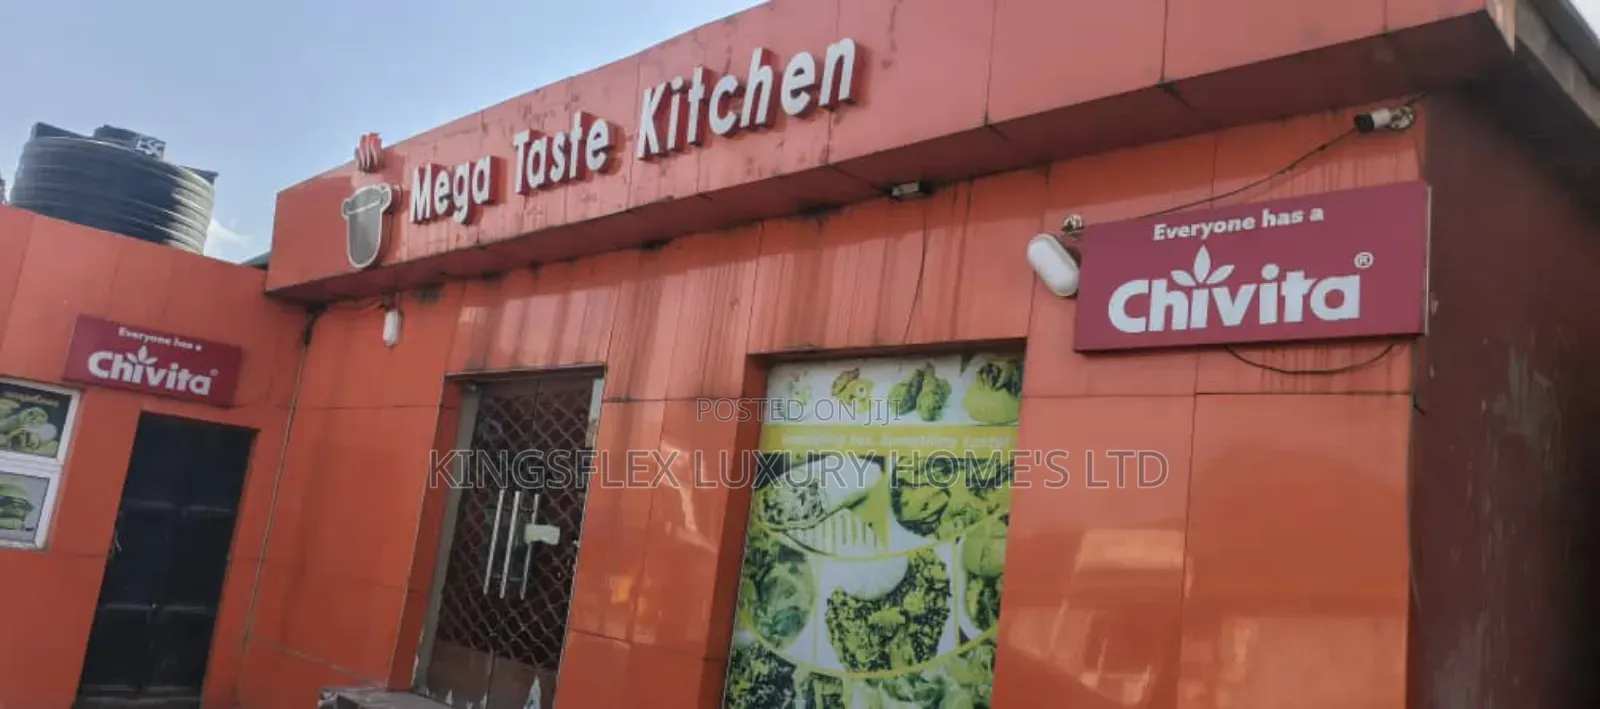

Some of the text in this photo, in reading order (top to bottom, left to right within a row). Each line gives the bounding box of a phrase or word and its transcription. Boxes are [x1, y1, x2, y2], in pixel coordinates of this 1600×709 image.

[409, 37, 857, 224] Mega Taste Kitchen
[1152, 207, 1325, 242] Everyone has a
[1107, 262, 1361, 334] Chivita
[117, 326, 172, 348] Everyone
[87, 350, 213, 396] Chivita
